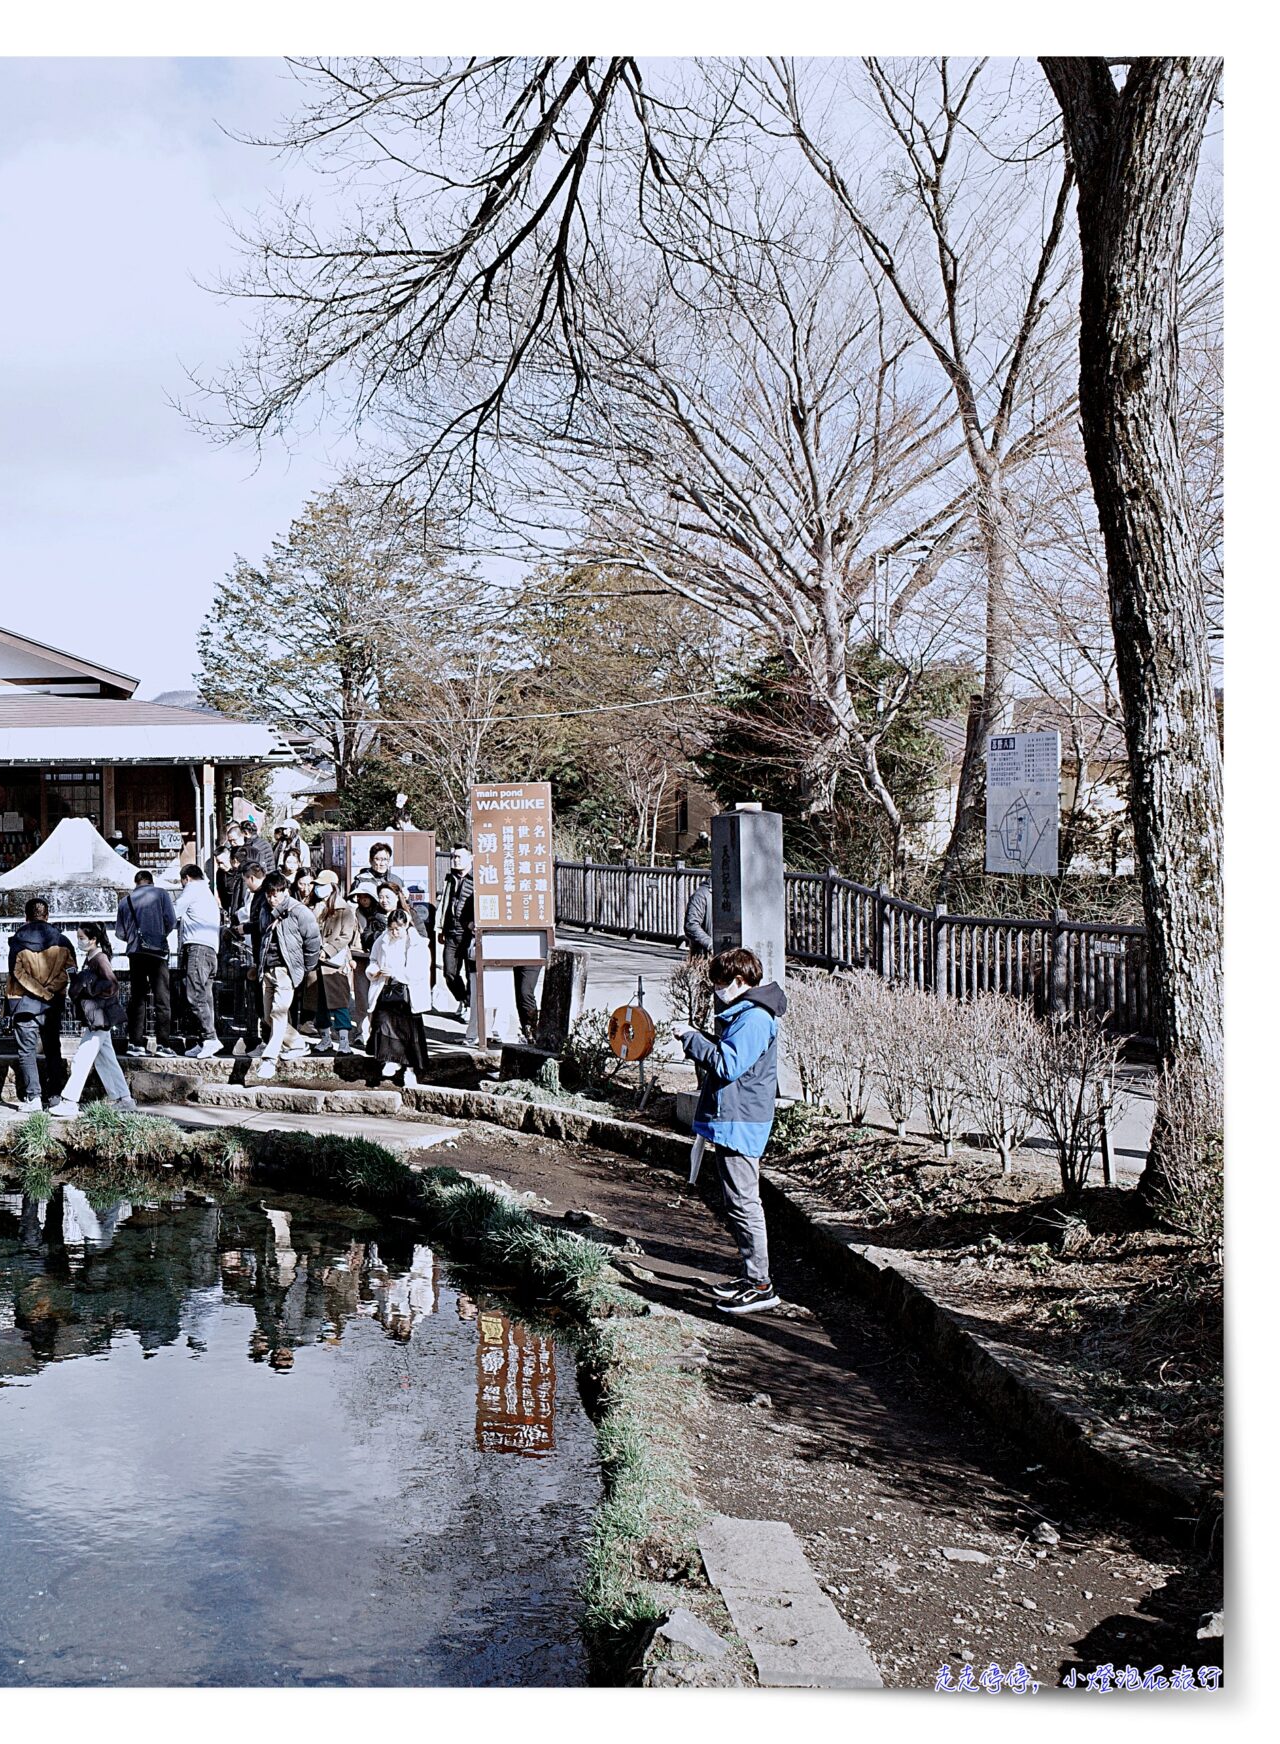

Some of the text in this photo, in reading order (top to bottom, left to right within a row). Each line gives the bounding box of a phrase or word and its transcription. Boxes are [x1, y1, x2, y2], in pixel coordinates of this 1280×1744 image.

[476, 789, 523, 799] main pond
[476, 799, 545, 811] WAKUIKE
[517, 825, 532, 892] 世界遺産
